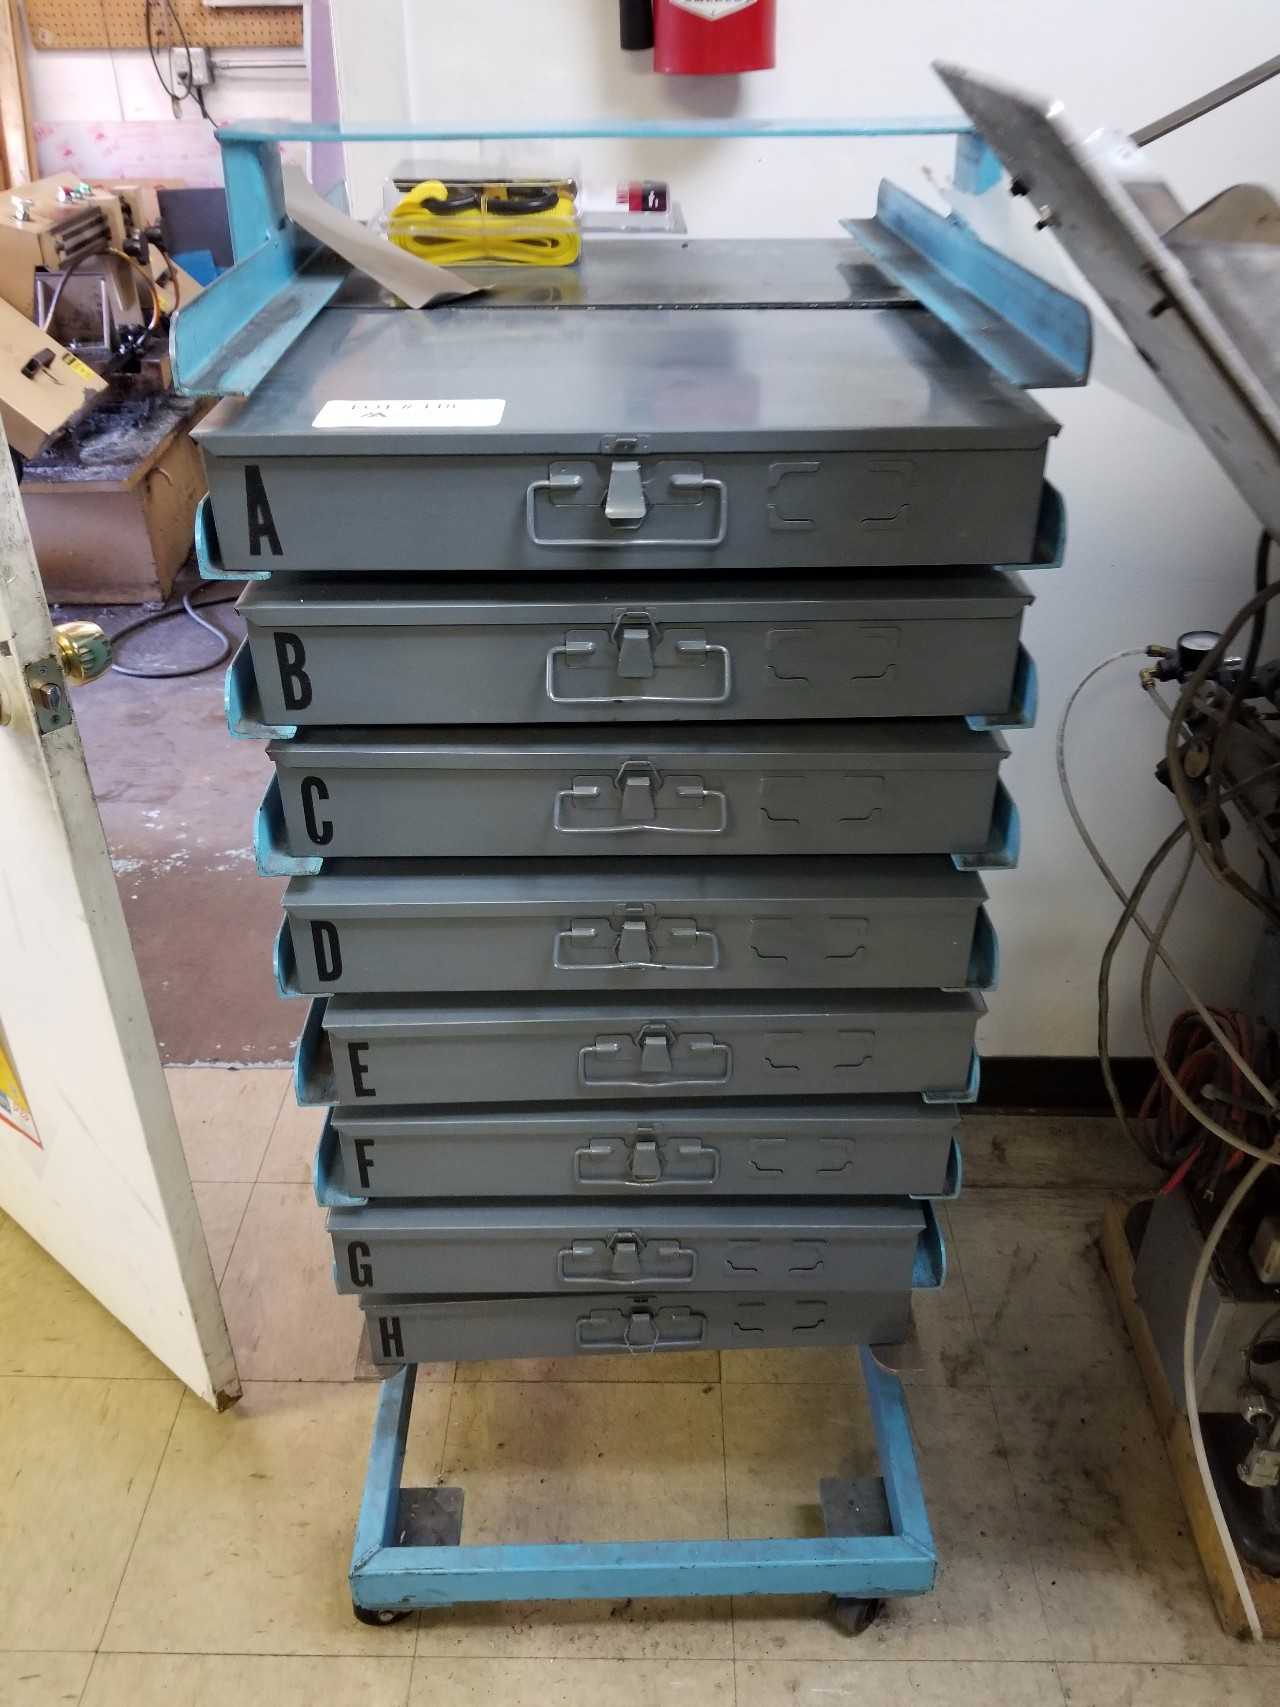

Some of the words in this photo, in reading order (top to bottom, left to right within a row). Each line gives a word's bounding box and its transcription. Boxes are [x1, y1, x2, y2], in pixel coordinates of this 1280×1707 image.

[245, 465, 283, 556] A
[274, 632, 312, 711] B
[301, 776, 333, 845] C
[311, 921, 342, 982] D
[348, 1042, 376, 1096] E
[354, 1139, 375, 1188] F
[348, 1241, 373, 1287] G
[379, 1316, 404, 1357] H
